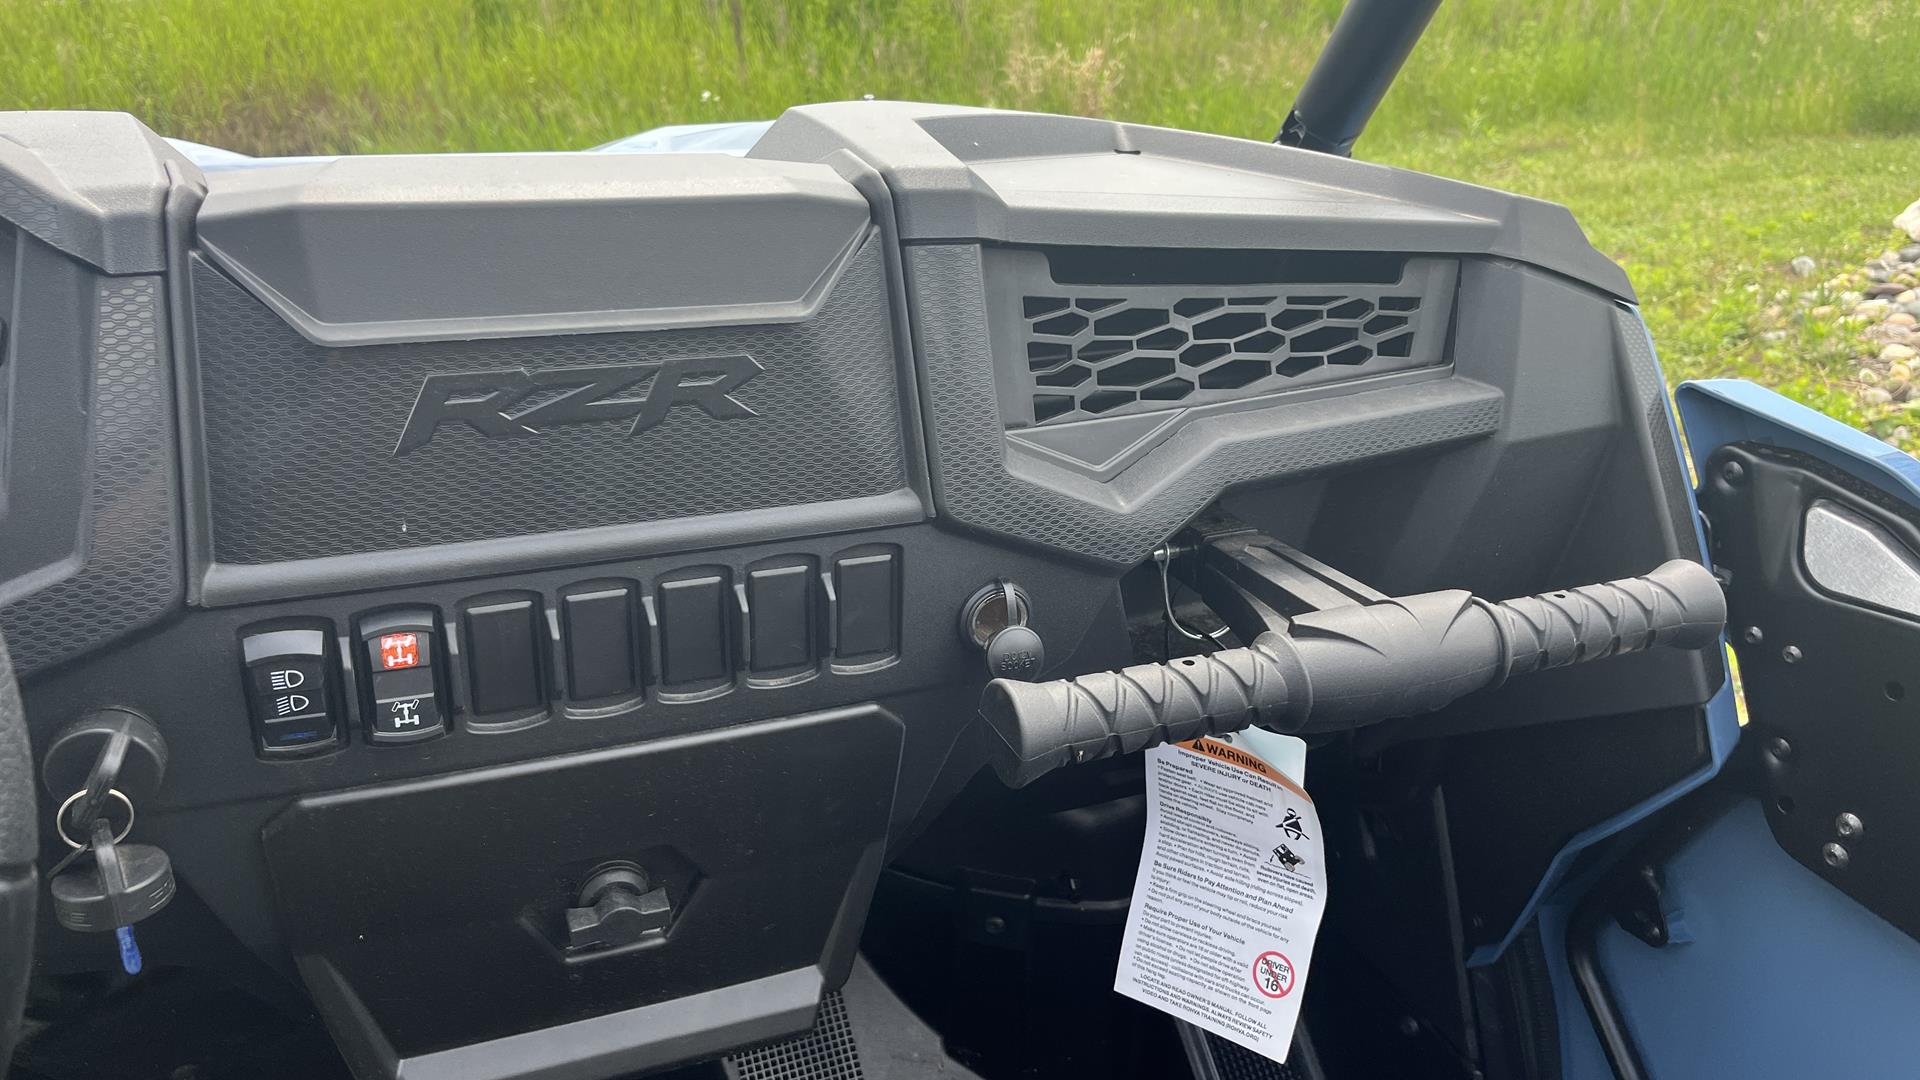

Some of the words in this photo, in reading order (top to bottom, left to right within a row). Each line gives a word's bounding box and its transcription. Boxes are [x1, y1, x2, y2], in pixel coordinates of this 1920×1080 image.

[392, 354, 766, 456] RZR
[1176, 748, 1206, 763] Improper
[1206, 759, 1230, 772] Vehicle
[1230, 767, 1244, 776] Use
[1243, 772, 1256, 781] Can
[1256, 776, 1277, 788] Result
[1190, 760, 1217, 773] SEVERE
[1217, 769, 1240, 781] INJURY
[1248, 780, 1271, 792] DEATH
[1204, 742, 1268, 773] WARNING
[1153, 859, 1162, 867] Be
[1162, 862, 1177, 872] Sure
[1176, 867, 1197, 879] Riders
[1196, 874, 1204, 882] to
[1203, 877, 1215, 886] Pay
[1215, 881, 1245, 897] Attention
[1244, 891, 1258, 901] and
[1257, 896, 1272, 906] Plan
[1271, 901, 1293, 914] Ahead
[1143, 902, 1168, 916] Require
[1167, 911, 1188, 924] Proper
[1188, 919, 1201, 928] Use
[1200, 923, 1208, 931] of
[1207, 926, 1222, 936] Your
[1222, 932, 1246, 945] Vehicle
[1259, 966, 1288, 982] UNDER
[1260, 957, 1290, 974] DRIVER
[1262, 976, 1280, 992] 16
[1131, 976, 1170, 996] INSTRUCTIONS
[1169, 992, 1181, 1001] AND
[1210, 1009, 1231, 1022] ALWAYS
[1231, 1018, 1253, 1031] REVIEW
[1252, 1026, 1272, 1039] SAFETY
[1139, 972, 1161, 985] LOCATE
[1160, 981, 1171, 989] AND
[1171, 985, 1186, 996] READ
[1185, 991, 1211, 1006] OWNER'S
[1234, 1011, 1257, 1025] FOLLOW
[1256, 1020, 1268, 1029] ALL
